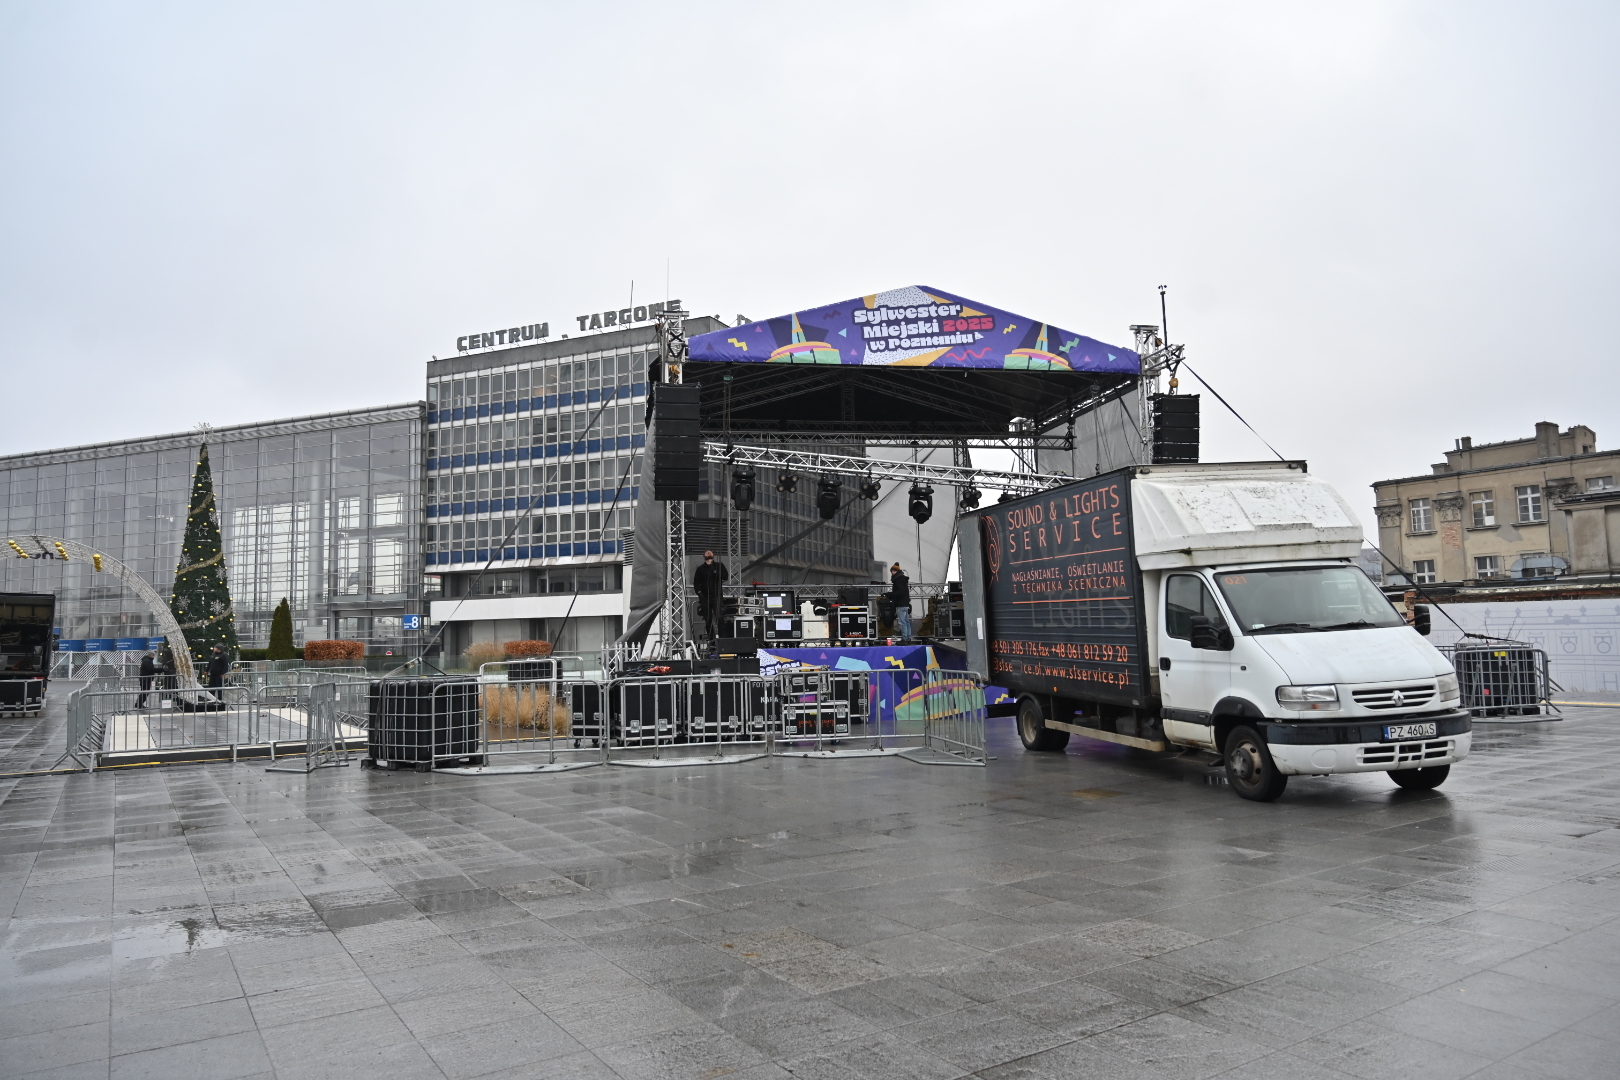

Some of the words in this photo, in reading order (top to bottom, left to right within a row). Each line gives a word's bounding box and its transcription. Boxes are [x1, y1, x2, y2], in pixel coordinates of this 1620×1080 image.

[854, 304, 961, 324] Sylwester
[457, 322, 550, 351] CENTRUM
[576, 299, 682, 331] TARGOWE
[863, 319, 940, 338] Miejski
[943, 317, 994, 332] 2025
[869, 340, 886, 351] w
[1007, 504, 1043, 530] SOUND
[1050, 501, 1057, 521] &
[1065, 484, 1120, 518] LIGHTS
[1009, 512, 1123, 553] SERVICE
[1067, 560, 1125, 577] OŚWIETLANIE
[1013, 584, 1017, 594] I
[1022, 581, 1063, 594] TECHNIKA
[1068, 575, 1126, 591] SCENICZNA
[1224, 576, 1248, 585] 021
[411, 616, 419, 628] 8
[1000, 641, 1010, 654] 501
[1012, 641, 1024, 655] 305
[1051, 643, 1066, 658] +48
[1067, 644, 1081, 659] 061
[1083, 644, 1100, 660] 812
[1102, 645, 1113, 661] 59
[1115, 645, 1129, 662] 20
[1390, 726, 1404, 738] PZ
